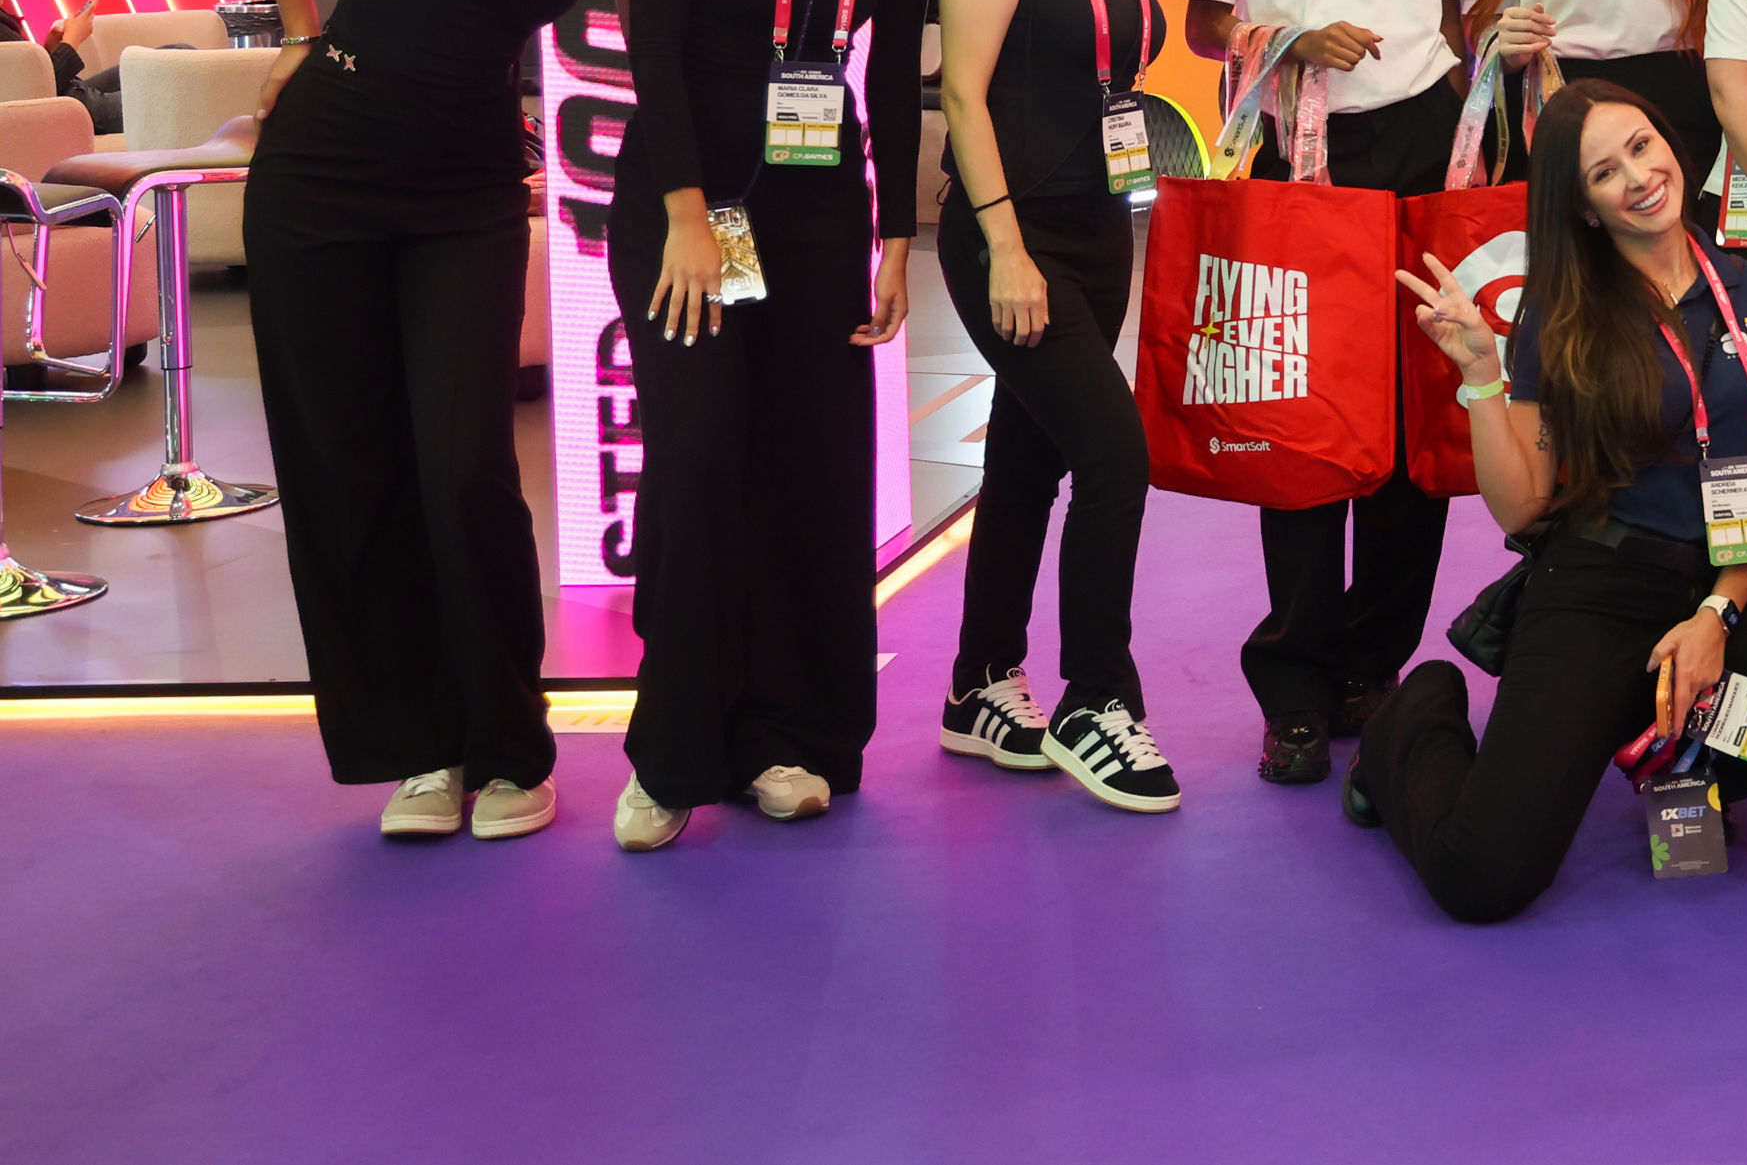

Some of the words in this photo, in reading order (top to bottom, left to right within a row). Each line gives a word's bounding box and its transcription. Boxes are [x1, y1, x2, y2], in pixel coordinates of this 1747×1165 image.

[804, 73, 834, 81] AMERICA
[1194, 253, 1308, 327] FLYING
[1223, 314, 1308, 356] EVEN
[1182, 332, 1308, 406] HIGHER
[1221, 439, 1271, 453] SmartSoft
[1710, 469, 1733, 477] SOUTH
[1660, 805, 1706, 821] 1XBET
